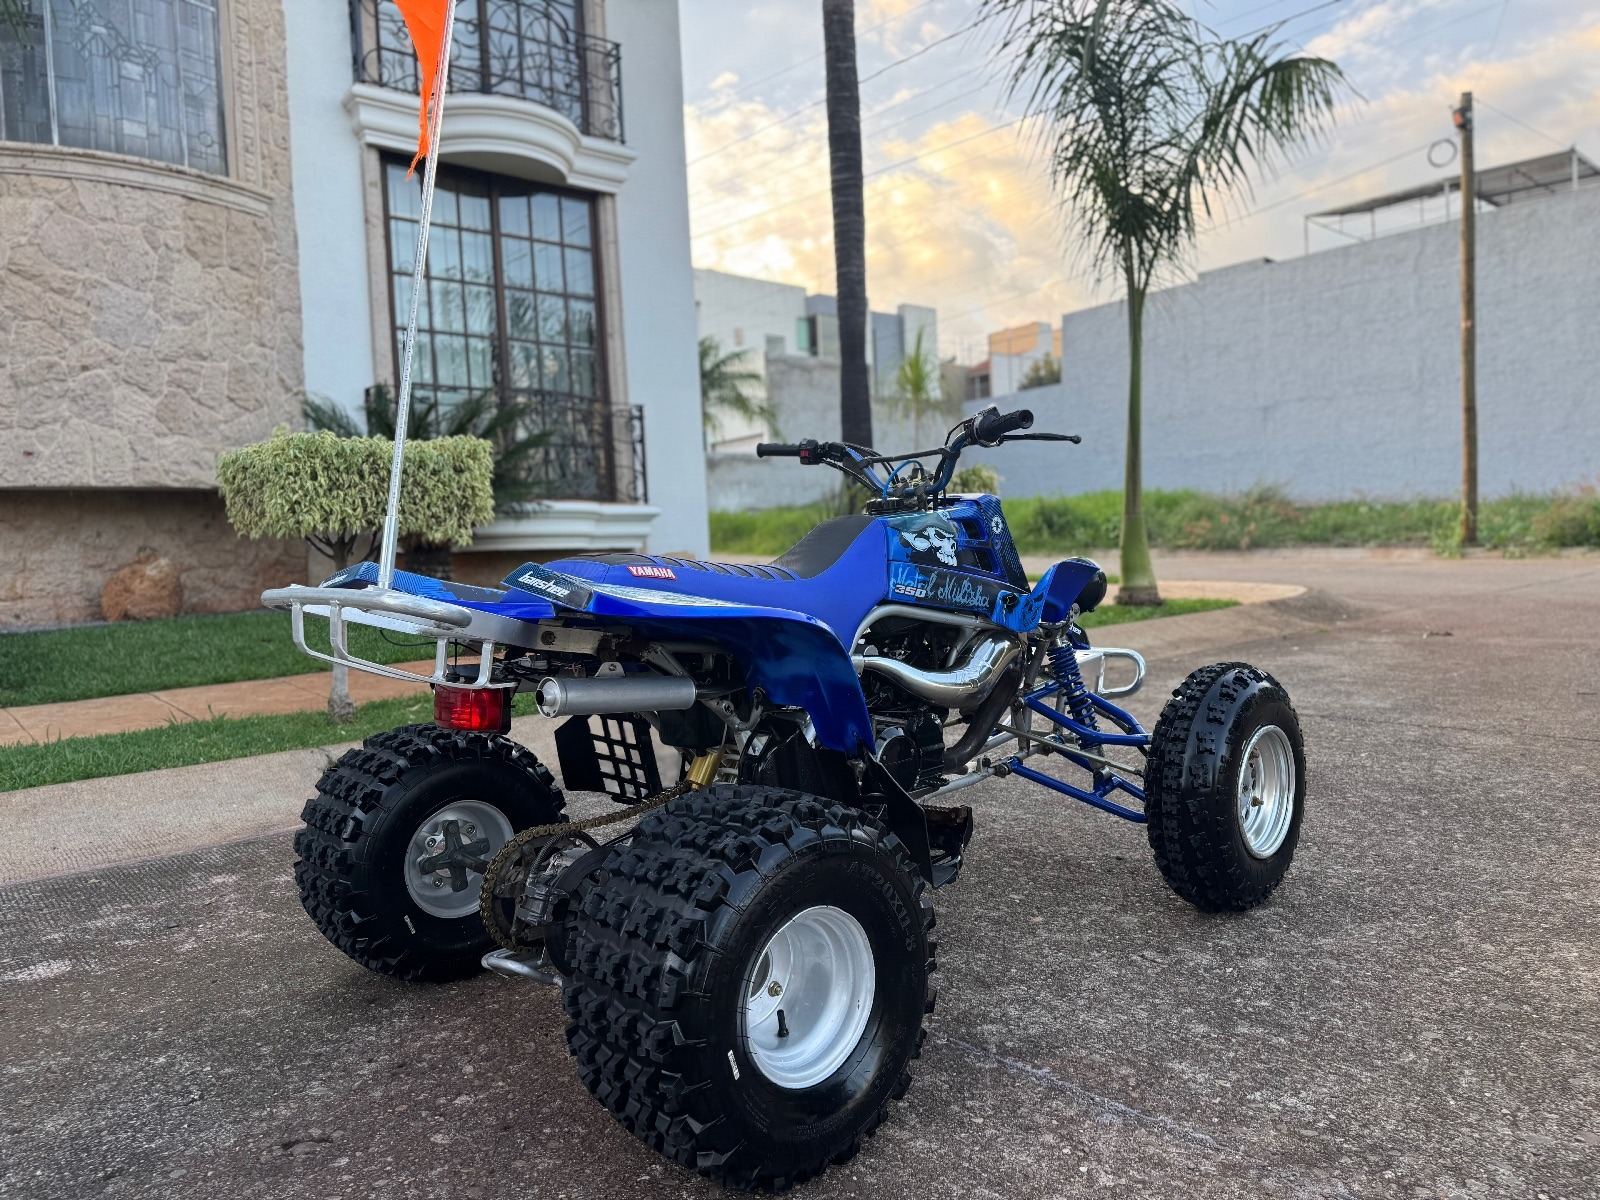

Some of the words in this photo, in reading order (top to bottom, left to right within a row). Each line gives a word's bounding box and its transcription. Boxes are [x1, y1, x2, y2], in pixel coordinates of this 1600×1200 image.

[628, 566, 675, 579] YAMAHA
[518, 571, 570, 597] banshee
[895, 584, 927, 598] 350
